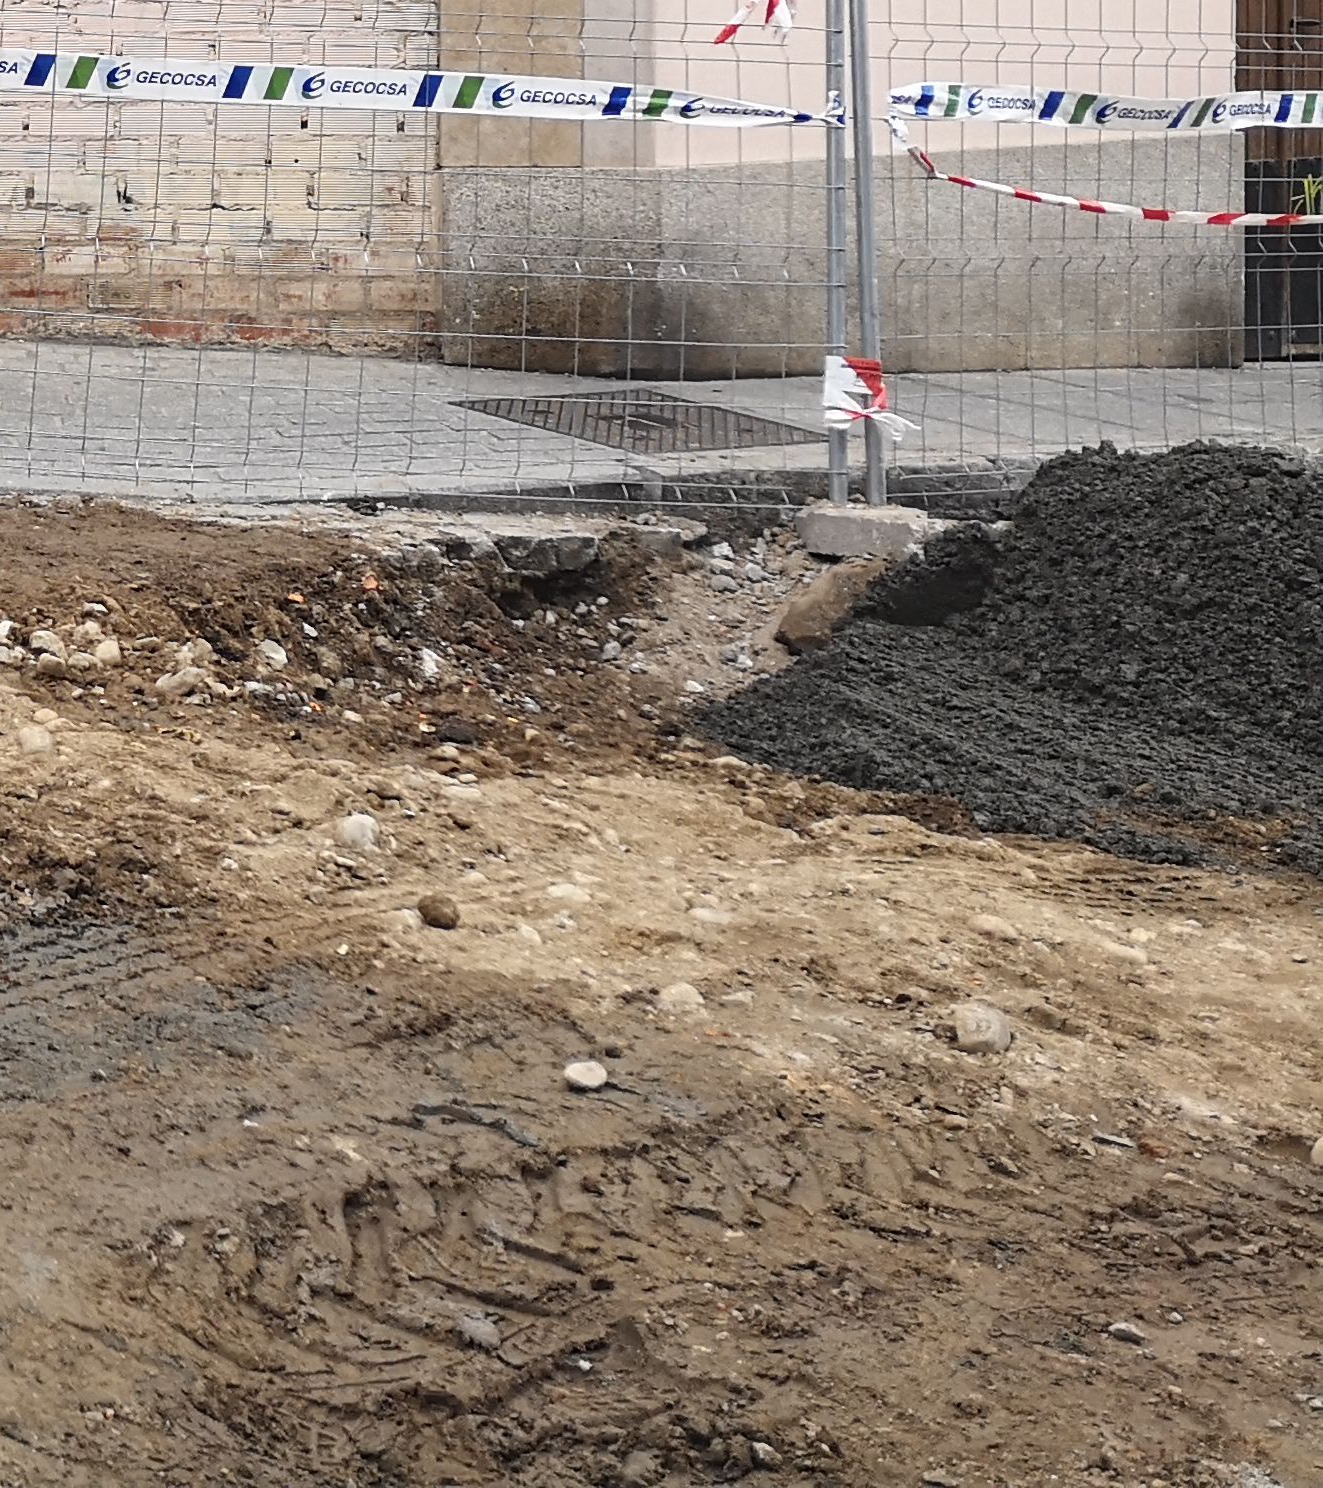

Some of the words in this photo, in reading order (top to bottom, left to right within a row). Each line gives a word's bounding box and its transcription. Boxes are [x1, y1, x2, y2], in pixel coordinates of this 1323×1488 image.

[135, 69, 218, 89] GECOCSA
[329, 79, 408, 97] GECOCSA
[519, 89, 598, 107] GECOCSA
